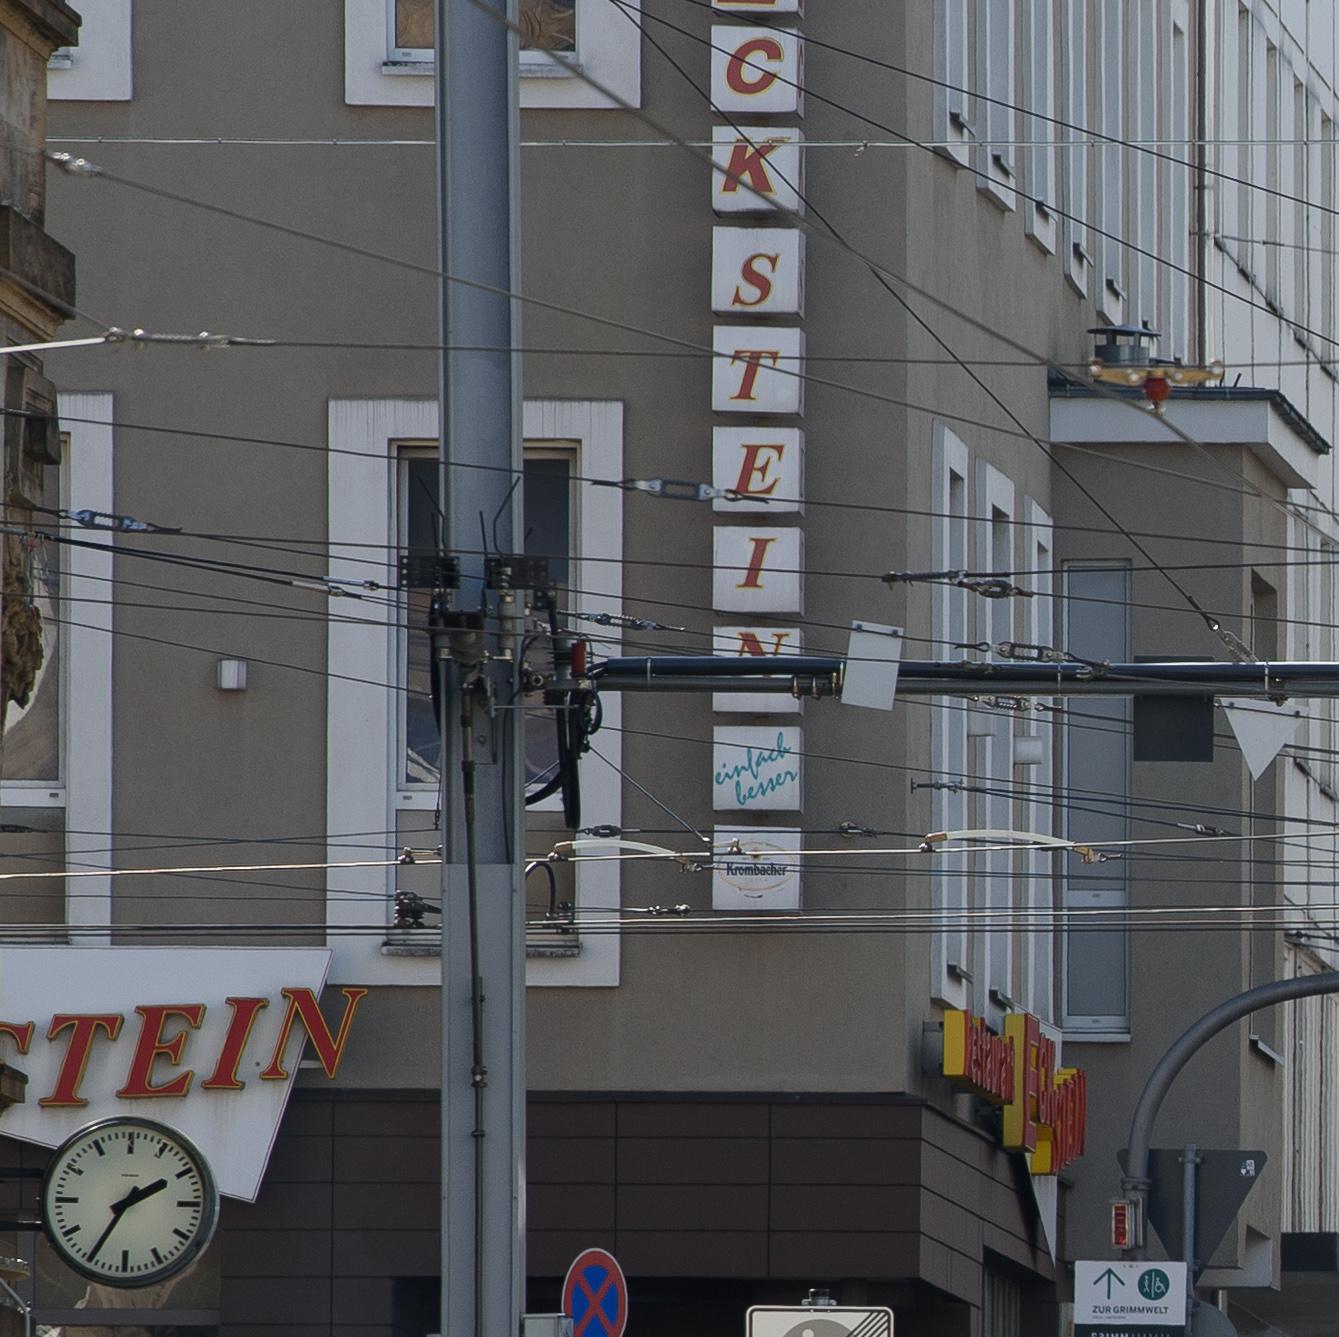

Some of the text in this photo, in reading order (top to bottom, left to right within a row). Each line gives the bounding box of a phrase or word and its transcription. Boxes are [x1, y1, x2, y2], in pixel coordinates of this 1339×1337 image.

[715, 731, 792, 785] einfach
[735, 770, 797, 806] besser
[726, 863, 788, 876] Krombacher
[1092, 1305, 1169, 1314] ZUR GRIMMWELT
